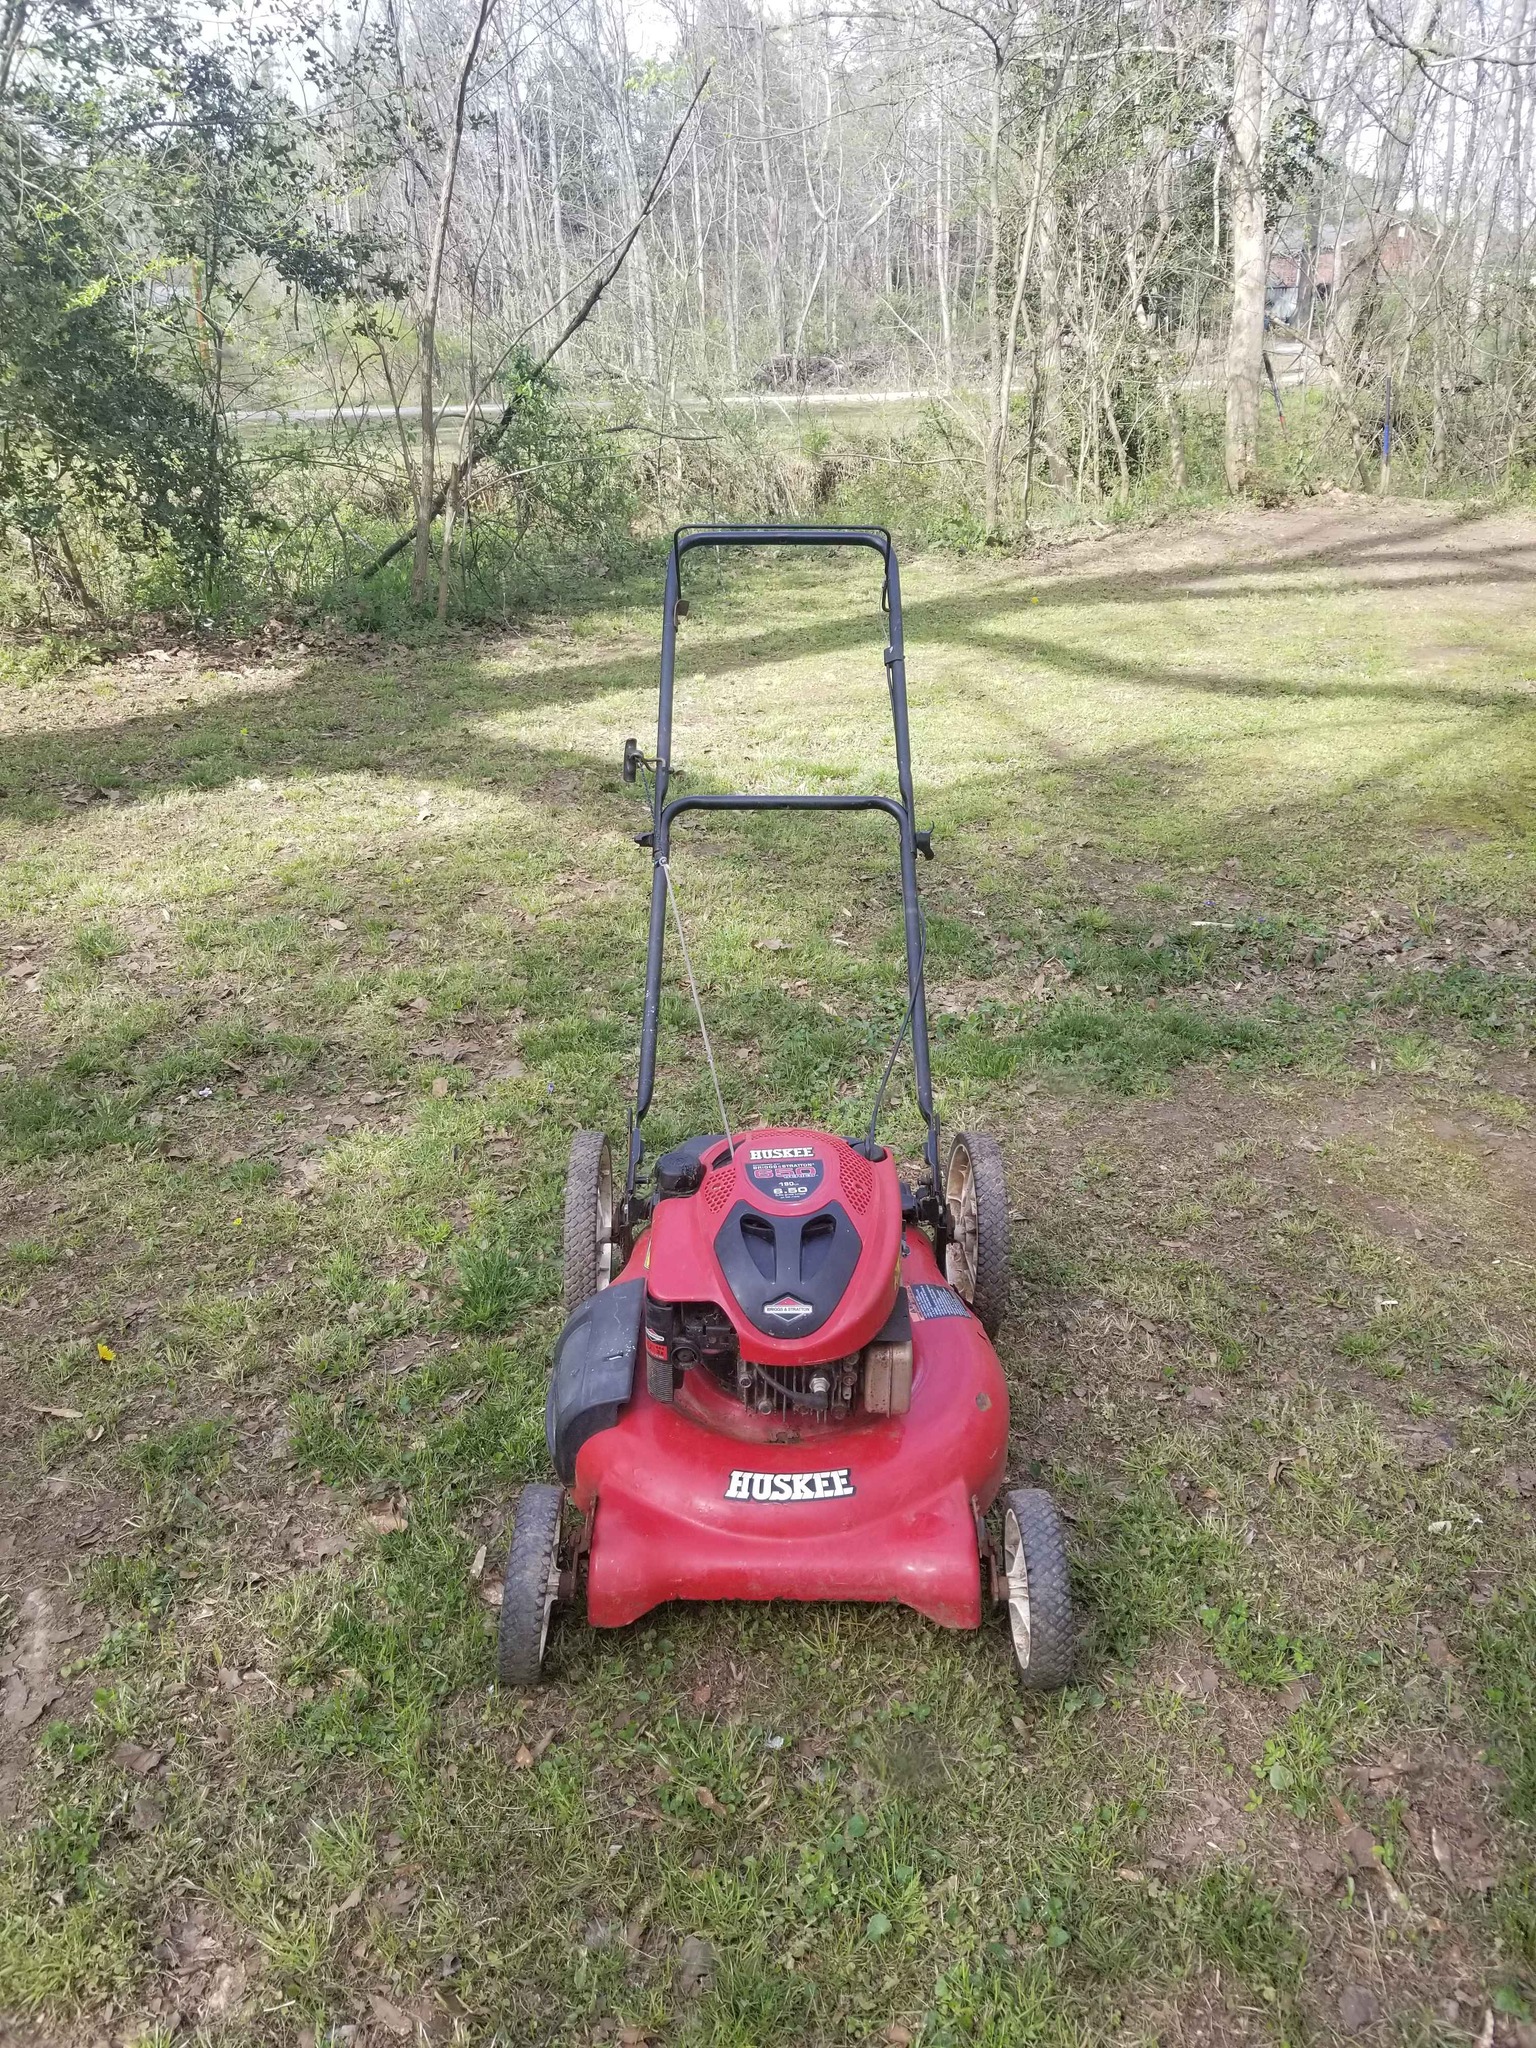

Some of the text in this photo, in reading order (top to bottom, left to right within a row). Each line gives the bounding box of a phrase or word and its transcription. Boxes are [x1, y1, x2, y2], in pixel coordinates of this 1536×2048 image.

[750, 1147, 814, 1160] HUSKEE
[754, 1167, 816, 1178] 650
[725, 1468, 854, 1500] HUSKEE
